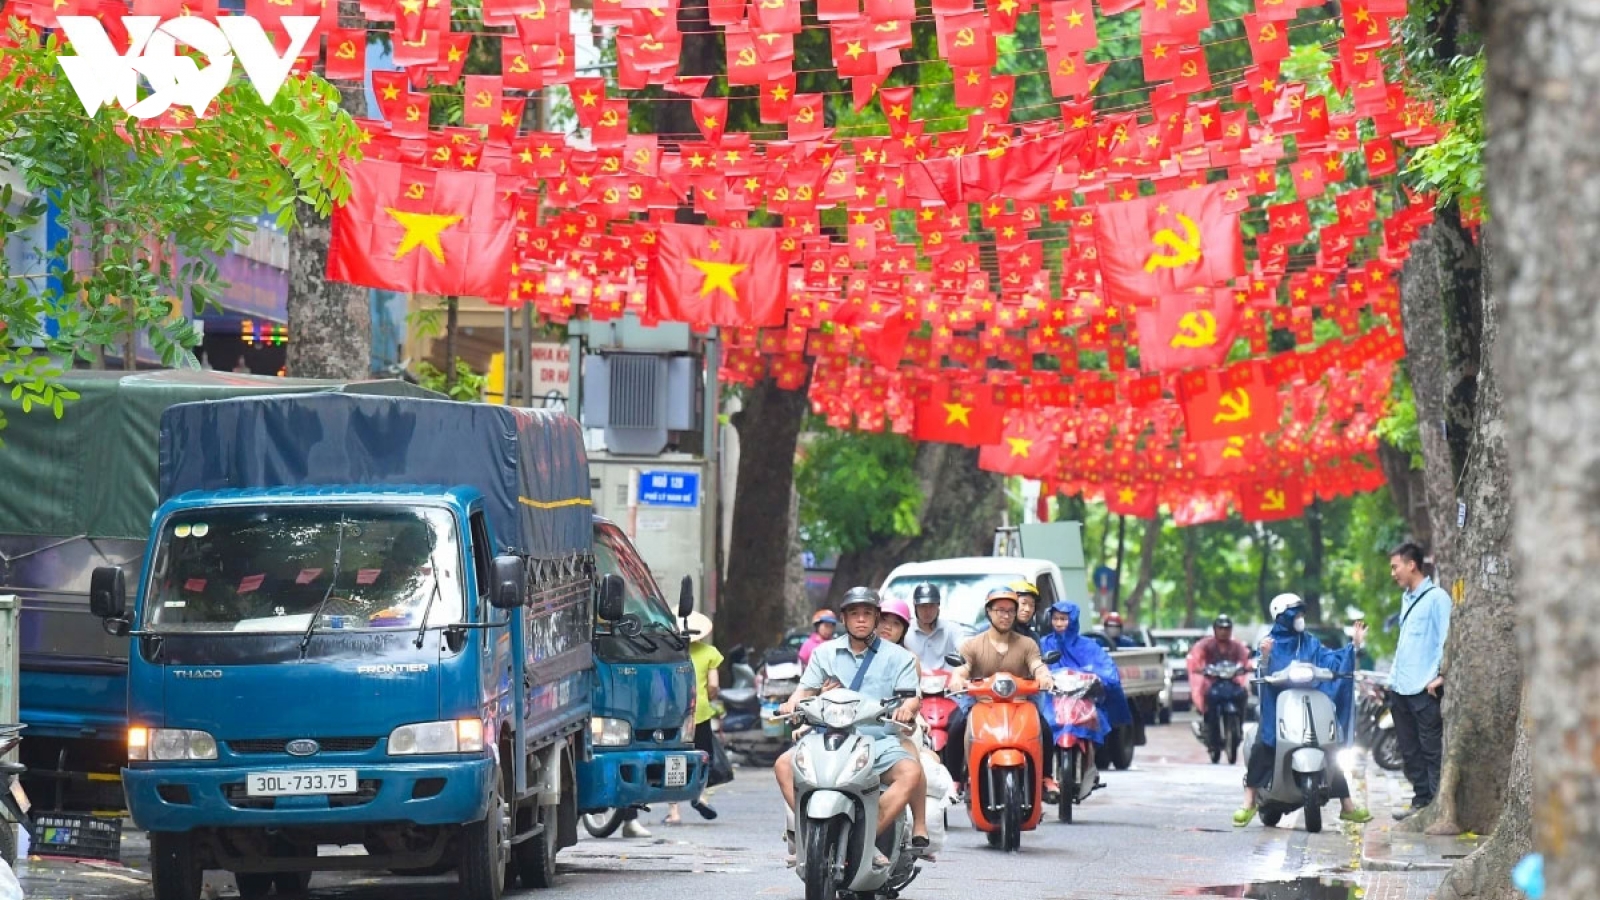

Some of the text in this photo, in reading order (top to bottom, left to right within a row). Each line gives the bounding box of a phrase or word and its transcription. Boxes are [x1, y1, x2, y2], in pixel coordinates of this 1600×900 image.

[358, 664, 428, 674] FRONTIER
[173, 670, 222, 678] THACO
[290, 743, 315, 752] KIA
[257, 775, 348, 791] 30L-733.75
